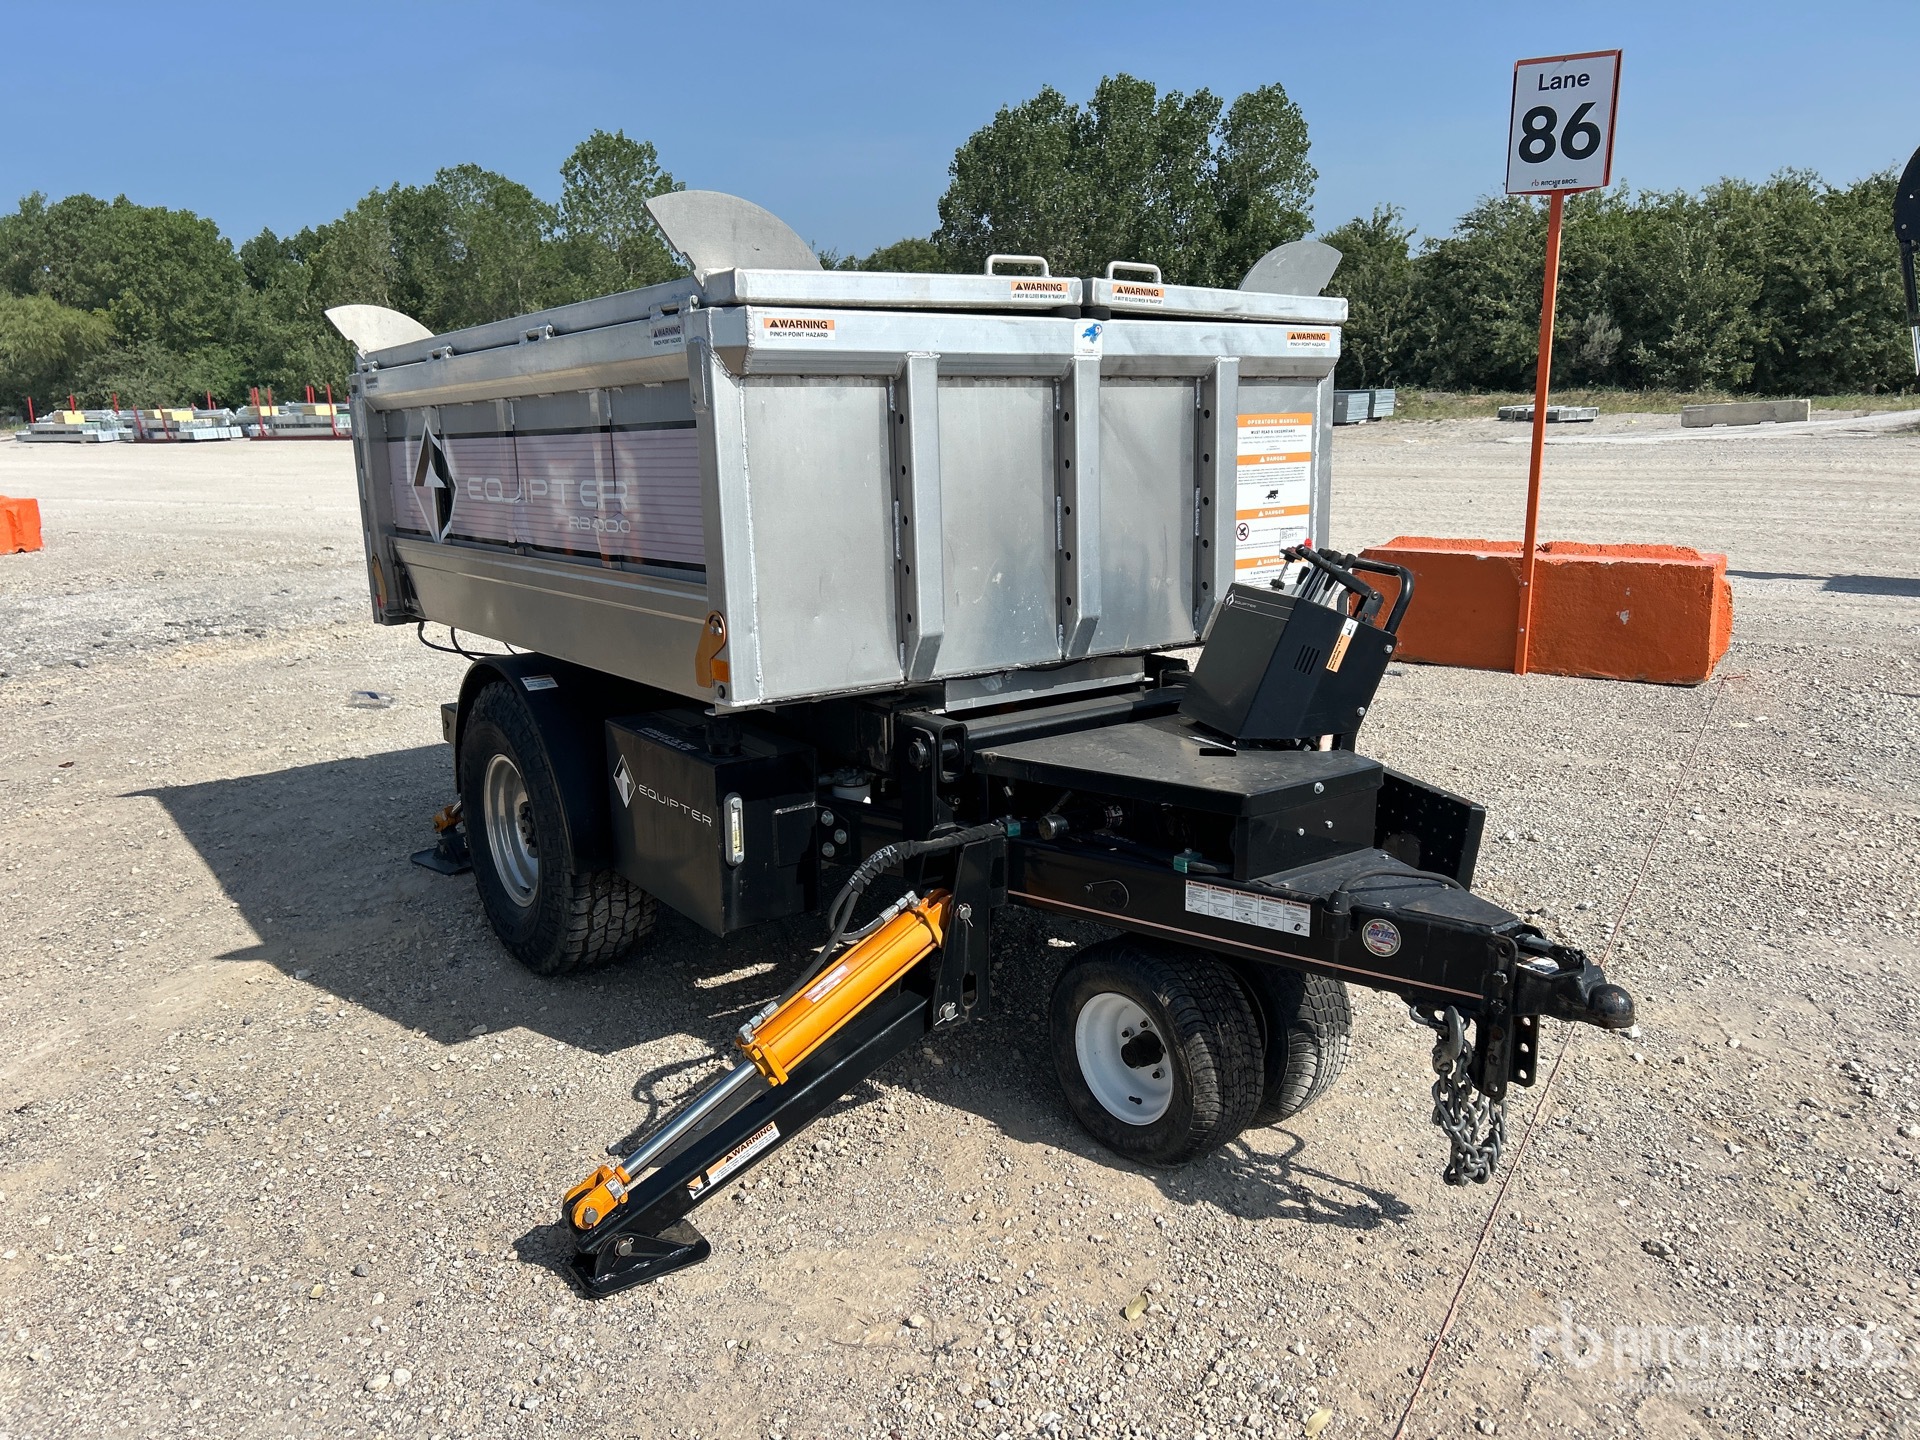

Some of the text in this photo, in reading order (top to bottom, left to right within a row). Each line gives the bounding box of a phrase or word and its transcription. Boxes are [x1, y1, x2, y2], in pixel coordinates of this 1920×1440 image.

[1538, 72, 1590, 91] Lane
[1518, 101, 1601, 164] 86
[1023, 282, 1063, 291] WARNING
[1123, 286, 1159, 297] WARNING
[657, 325, 681, 337] WARNING
[778, 319, 828, 330] WARNING
[1296, 333, 1326, 341] WARNING
[467, 476, 629, 510] EQUIPTER
[638, 783, 712, 827] EQUIPTER
[731, 1124, 774, 1157] WARNING
